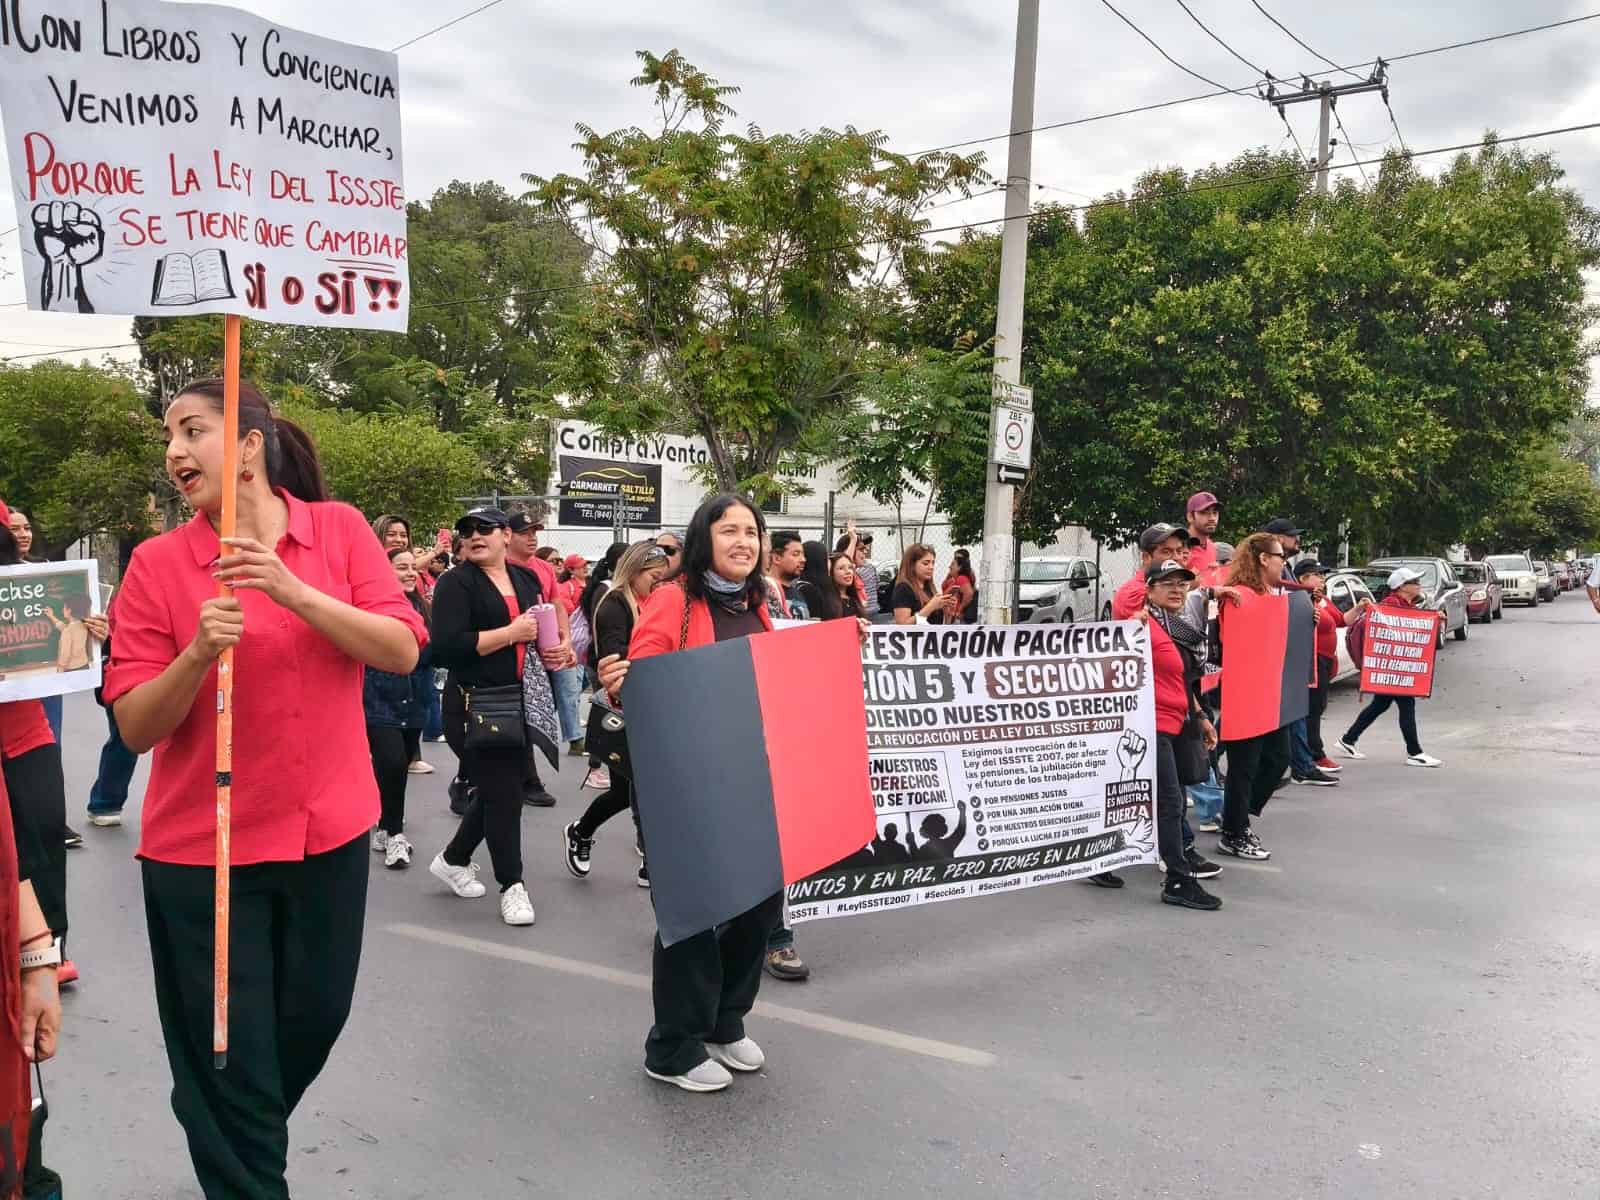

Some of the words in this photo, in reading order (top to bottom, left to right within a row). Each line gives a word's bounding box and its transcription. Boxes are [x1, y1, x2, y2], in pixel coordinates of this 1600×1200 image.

[101, 0, 200, 63] LIBROS
[231, 32, 247, 66] Y
[47, 75, 198, 126] VENIMOS
[230, 96, 245, 129] A
[258, 97, 393, 160] MARCHAR,
[24, 132, 145, 202] PORQUE
[169, 152, 201, 196] LA
[213, 149, 252, 197] LEY
[271, 169, 314, 204] DEL
[326, 169, 405, 210] ISSSTE
[119, 208, 167, 246] SE
[175, 209, 248, 242] TIENE
[255, 217, 295, 248] QUE
[306, 220, 407, 260] CAMBIAR
[570, 480, 619, 493] CARMARKET
[24, 603, 42, 617] es
[1014, 624, 1129, 657] PACÍFICA
[924, 668, 944, 700] 5
[960, 671, 976, 694] Y
[993, 657, 1105, 696] SECCIÓN
[1111, 659, 1139, 689] 38
[865, 707, 938, 728] DIENDO
[943, 700, 1052, 725] NUESTROS
[1055, 694, 1138, 717] DERECHOS
[884, 729, 960, 746] REVOCACIÓN
[963, 729, 980, 741] DE
[982, 728, 999, 740] LA
[1000, 726, 1022, 739] LEY
[1025, 724, 1049, 737] DEL
[1051, 721, 1091, 735] ISSSTE
[1093, 719, 1121, 731] 2007!
[962, 748, 1003, 759] Exigimos
[1015, 740, 1065, 754] revocación
[1067, 740, 1078, 748] de
[964, 760, 980, 770] Ley
[982, 758, 997, 767] del
[999, 754, 1034, 766] ISSSTE
[871, 774, 940, 791] DERECHOS
[965, 771, 978, 779] las
[985, 777, 1012, 789] futuro
[1014, 775, 1025, 785] de
[1027, 774, 1042, 784] los
[887, 793, 903, 806] SE
[907, 790, 947, 805] TOCAN!
[1107, 805, 1149, 825] FUERZA
[853, 873, 866, 891] Y
[871, 871, 897, 889] EN
[943, 860, 985, 879] PERO
[990, 852, 1041, 874] FIRMES
[1042, 848, 1062, 864] EN
[1065, 845, 1080, 860] LA
